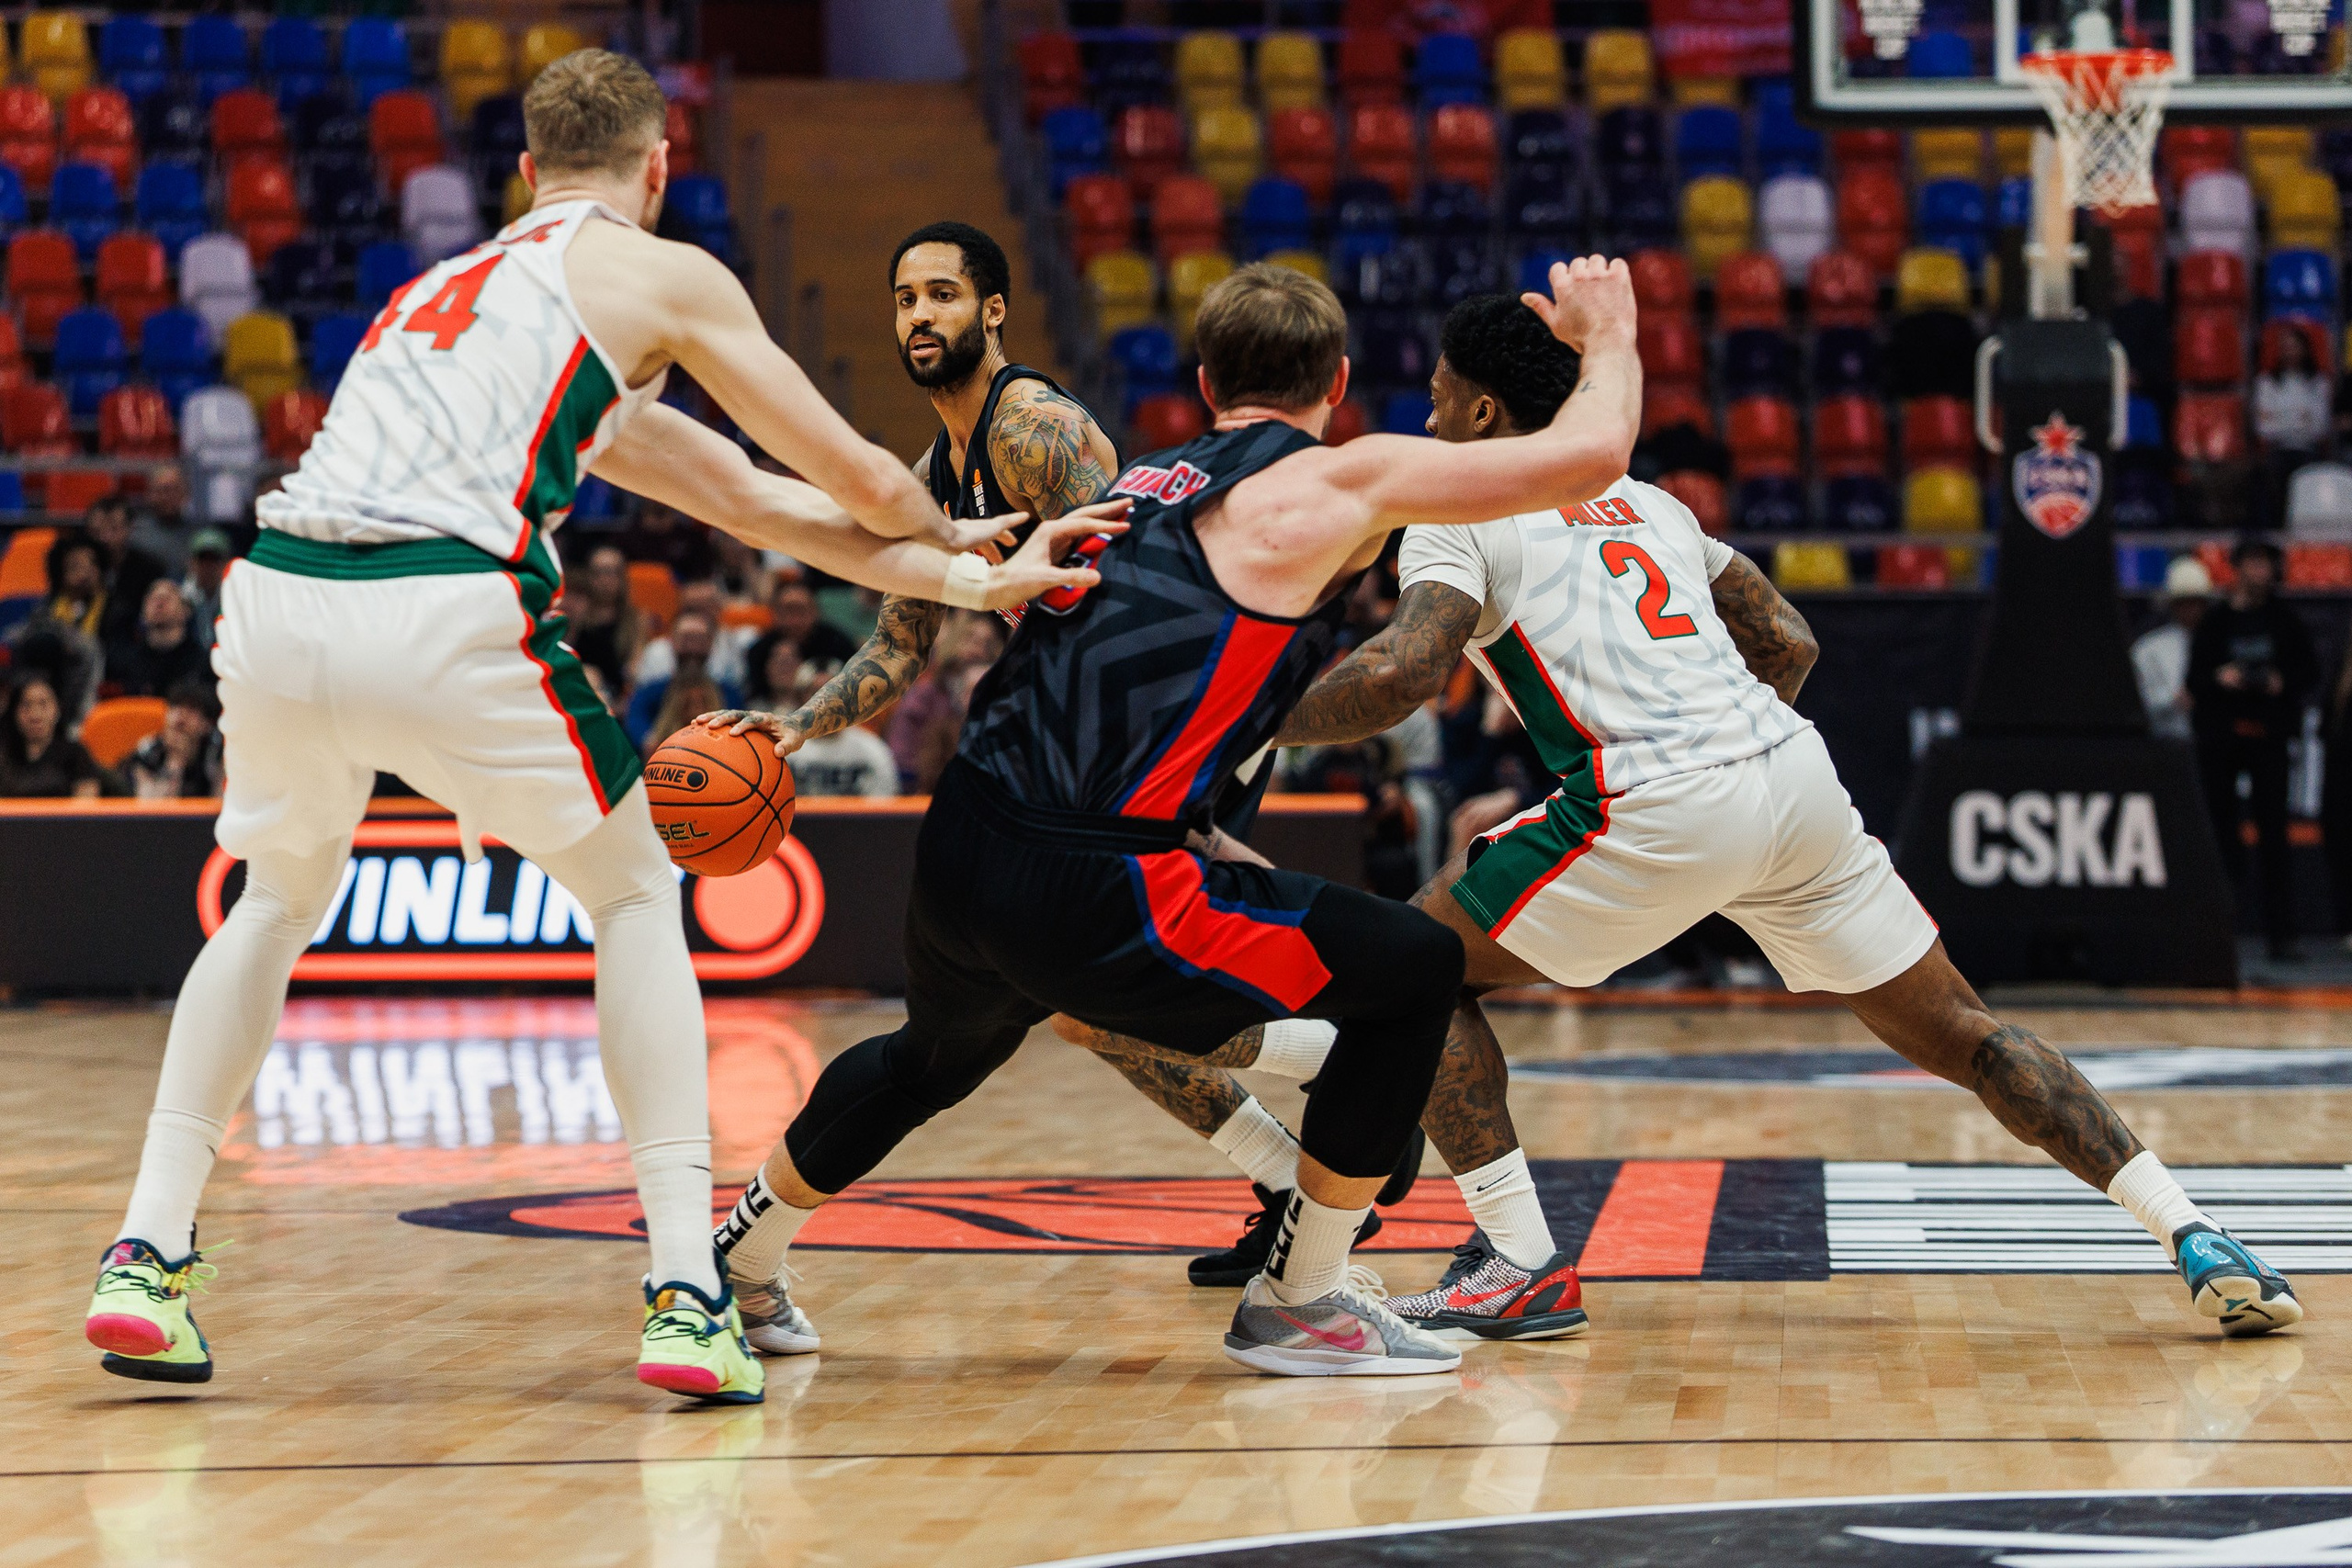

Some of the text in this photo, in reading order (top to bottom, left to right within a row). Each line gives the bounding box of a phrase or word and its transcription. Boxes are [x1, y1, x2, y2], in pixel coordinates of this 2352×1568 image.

[355, 250, 507, 353] 44
[1556, 497, 1646, 528] MILLER
[1599, 539, 1699, 640] 2
[1949, 790, 2168, 888] CSKA
